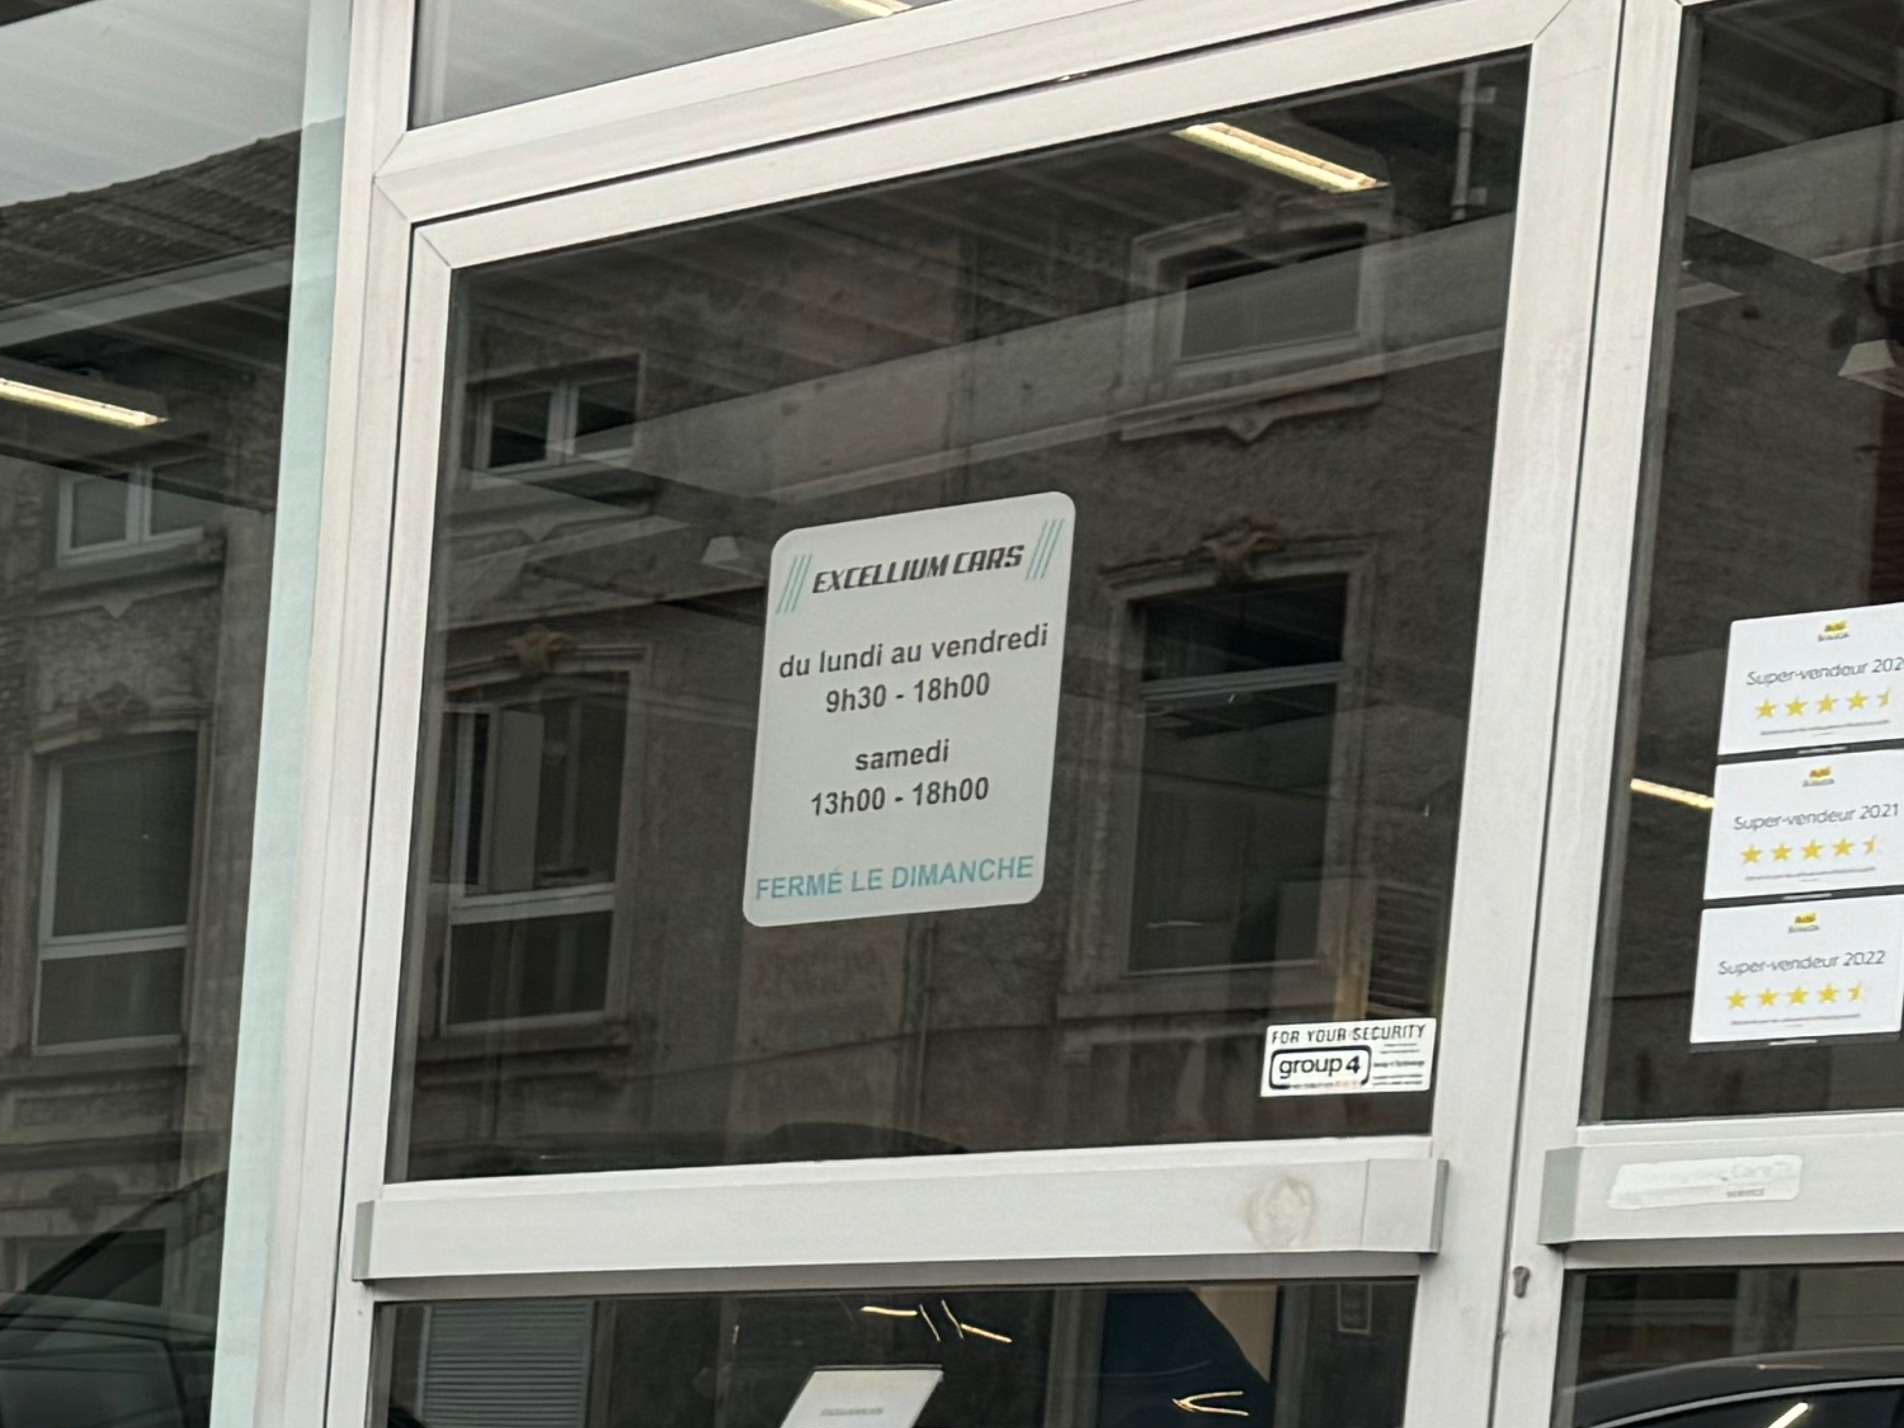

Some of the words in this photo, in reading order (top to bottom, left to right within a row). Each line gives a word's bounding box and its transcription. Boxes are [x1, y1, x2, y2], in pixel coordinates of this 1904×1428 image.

[812, 554, 951, 594] EXCELLIUM
[952, 545, 1024, 576] CARS
[779, 655, 810, 678] du
[819, 643, 883, 673] lundi
[892, 645, 921, 664] au
[932, 623, 1048, 659] vendredi
[826, 683, 887, 713] 9h30
[914, 671, 990, 703] 18h00
[1746, 662, 1869, 686] Super-vendeur
[855, 738, 950, 771] samedi
[810, 787, 886, 816] 13h00
[912, 777, 989, 806] 18h00
[1733, 809, 1856, 831] Super-vendeur
[1859, 803, 1899, 820] 2021
[755, 867, 842, 900] FERMÉ
[852, 868, 884, 892] LE
[892, 855, 1035, 889] DIMANCHE
[1717, 955, 1840, 976] Super-vendeur
[1843, 949, 1886, 967] 2022
[1271, 1031, 1300, 1044] FOR
[1308, 1027, 1346, 1042] YOUR
[1352, 1024, 1426, 1041] SECURITY
